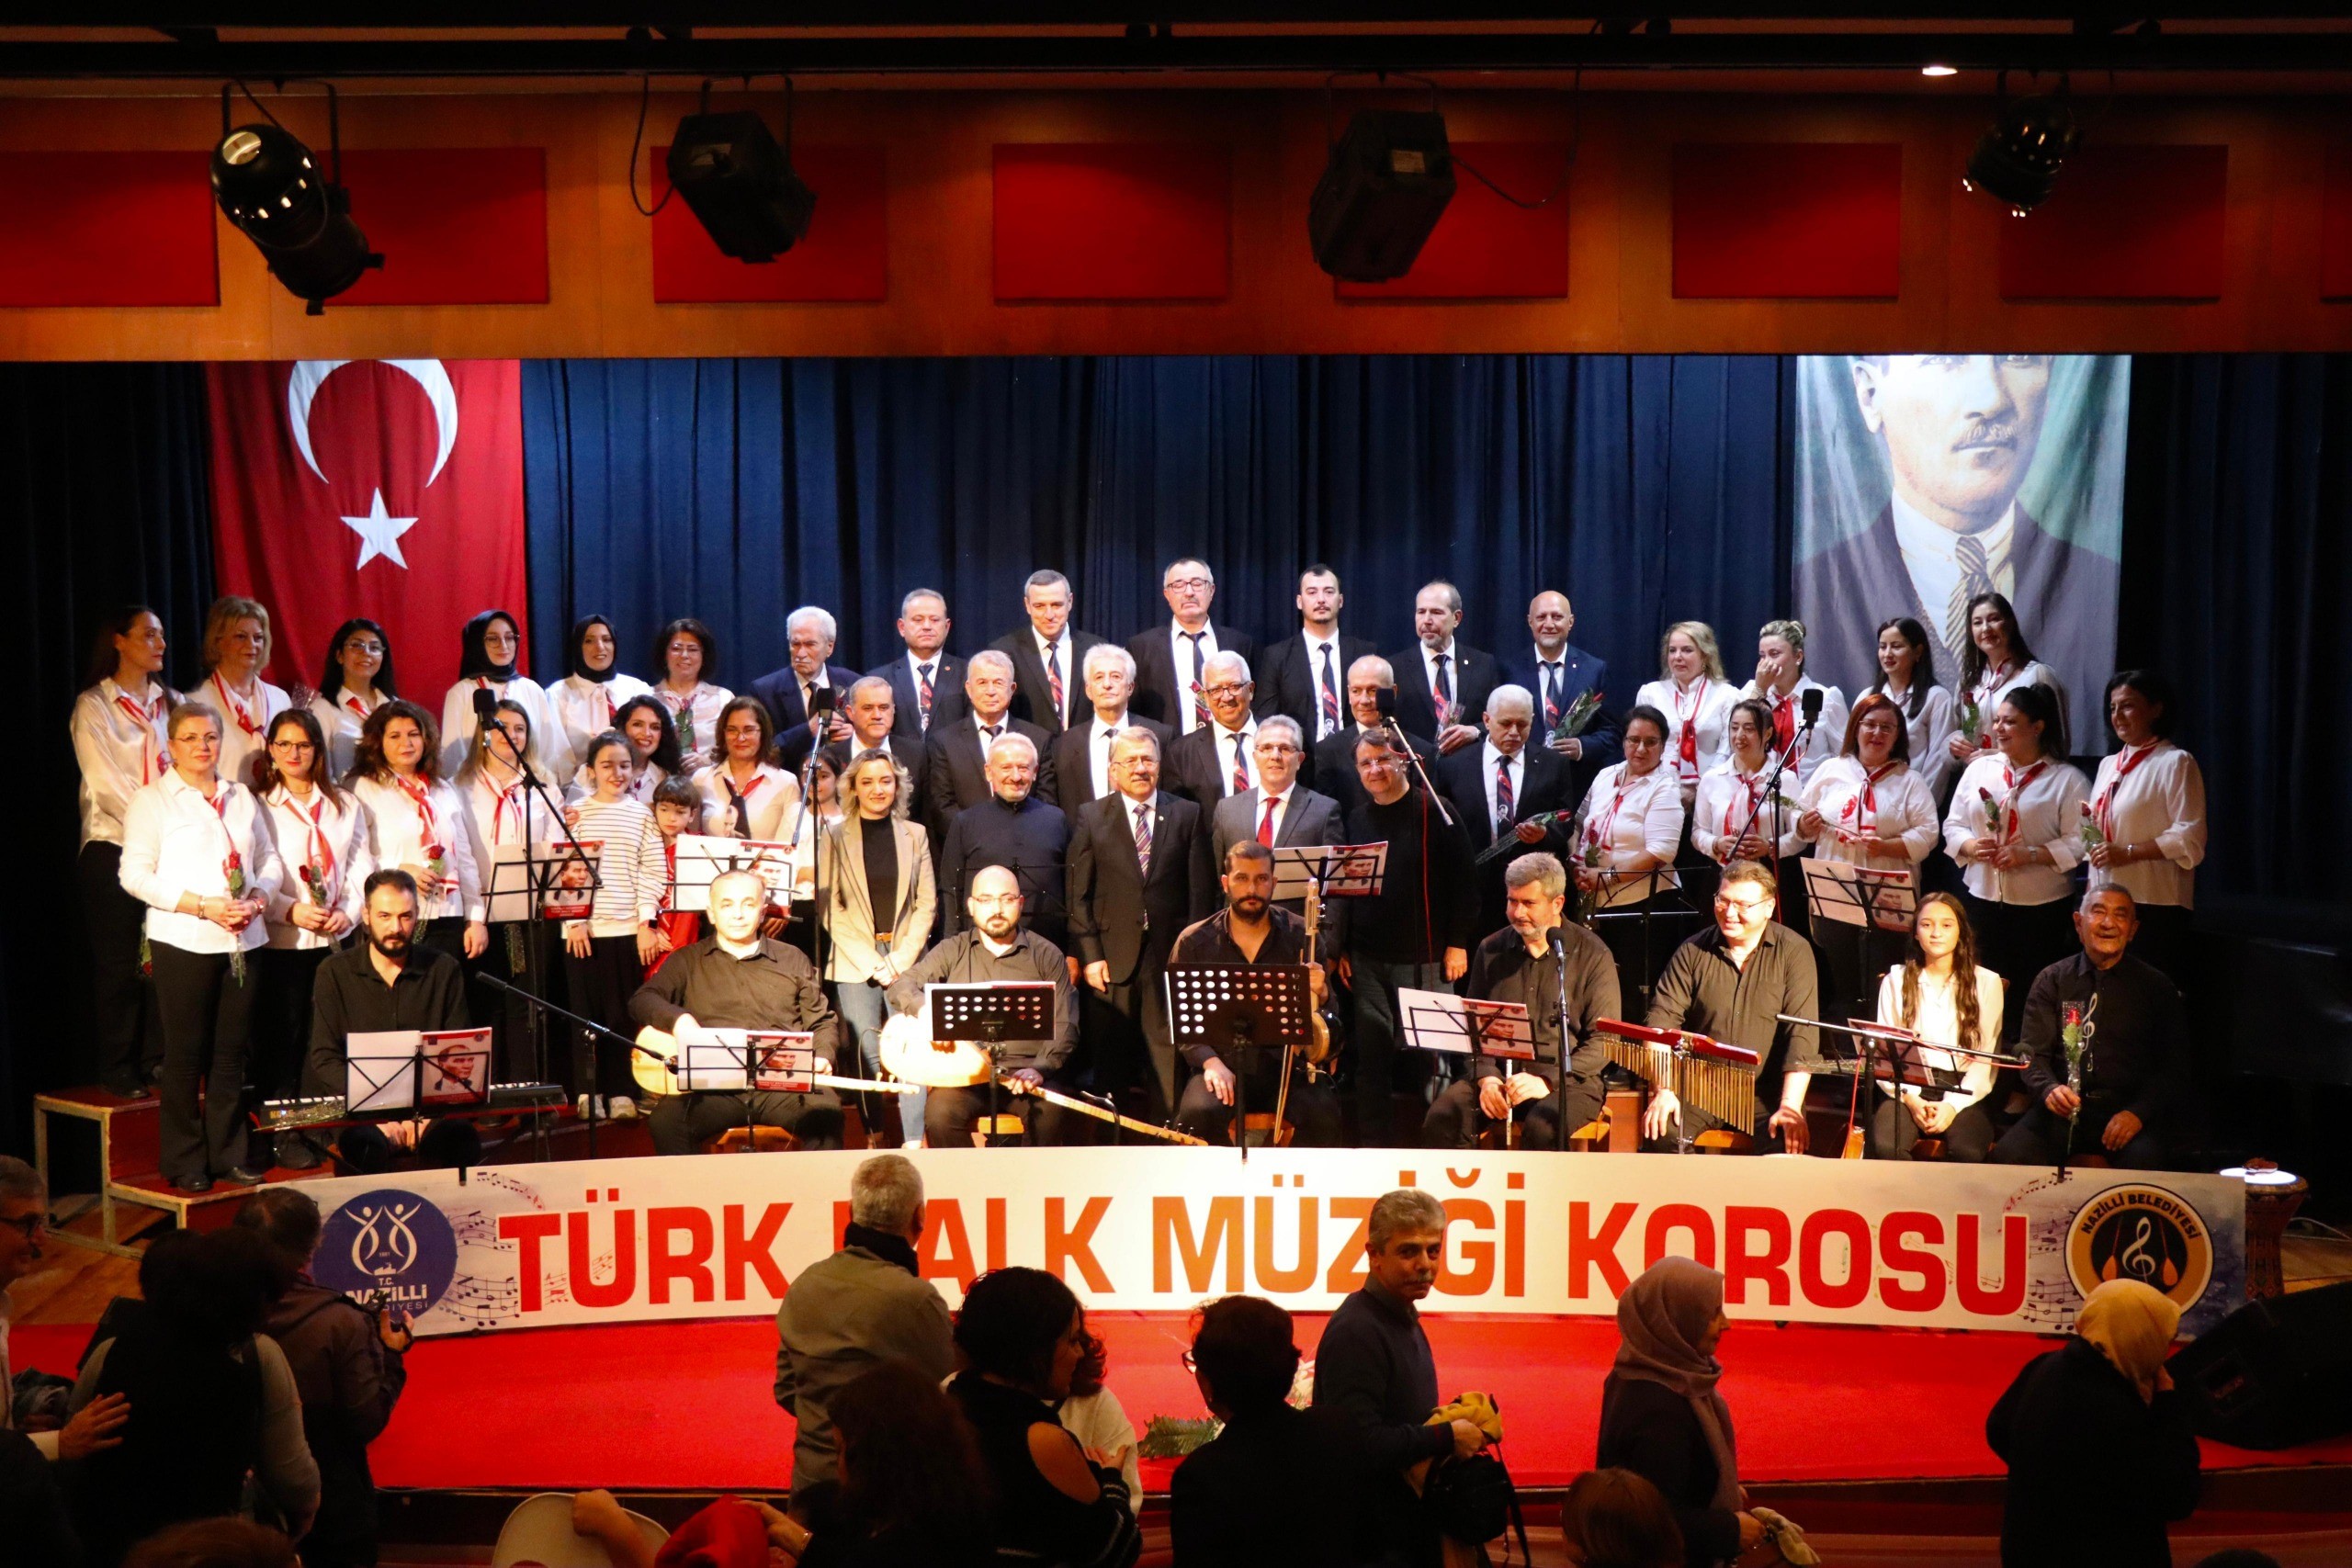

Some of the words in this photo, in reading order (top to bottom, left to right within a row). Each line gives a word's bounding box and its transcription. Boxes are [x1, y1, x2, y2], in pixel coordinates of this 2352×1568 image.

[2081, 1192, 2125, 1235] NAZİLLİ
[2128, 1193, 2202, 1240] BELEDİYESİ
[499, 1188, 794, 1312] TÜRK
[832, 1196, 1116, 1294] ALK
[1152, 1168, 1526, 1297] MÜZĞİ
[1567, 1201, 2028, 1316] KOROSU
[378, 1277, 394, 1286] T.C.
